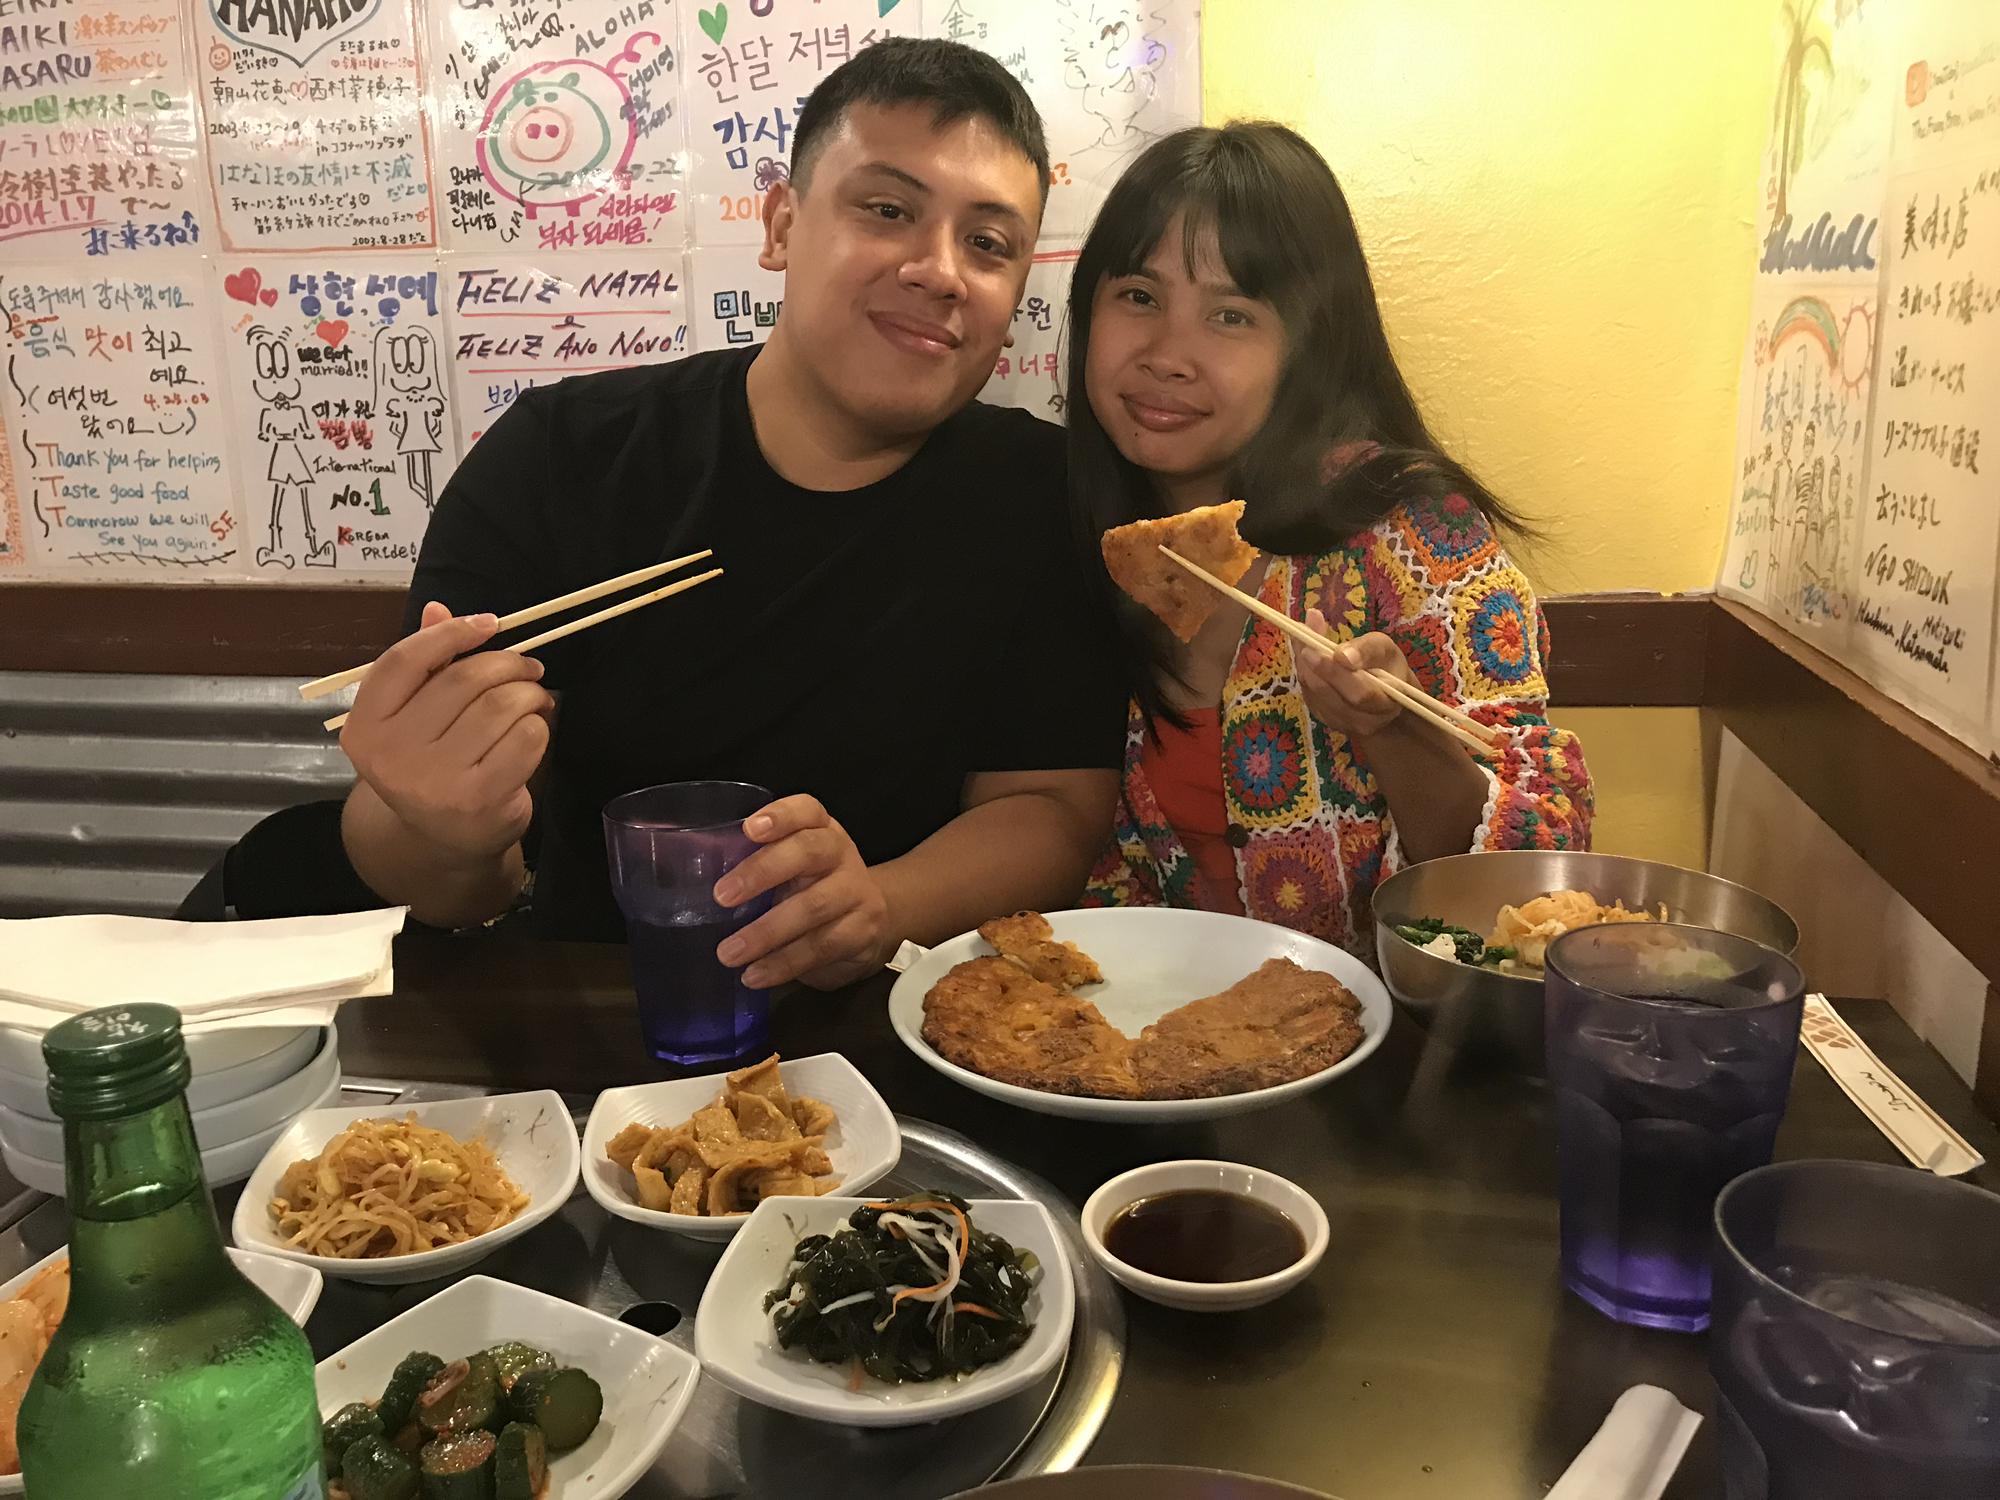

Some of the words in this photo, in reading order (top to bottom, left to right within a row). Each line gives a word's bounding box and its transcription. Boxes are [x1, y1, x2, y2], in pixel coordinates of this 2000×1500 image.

[576, 0, 655, 56] ALOHA
[697, 34, 779, 104] 한달
[719, 193, 764, 221] 201
[579, 268, 679, 299] NATAL
[35, 442, 100, 469] Thank
[109, 483, 145, 505] good
[150, 480, 191, 504] food
